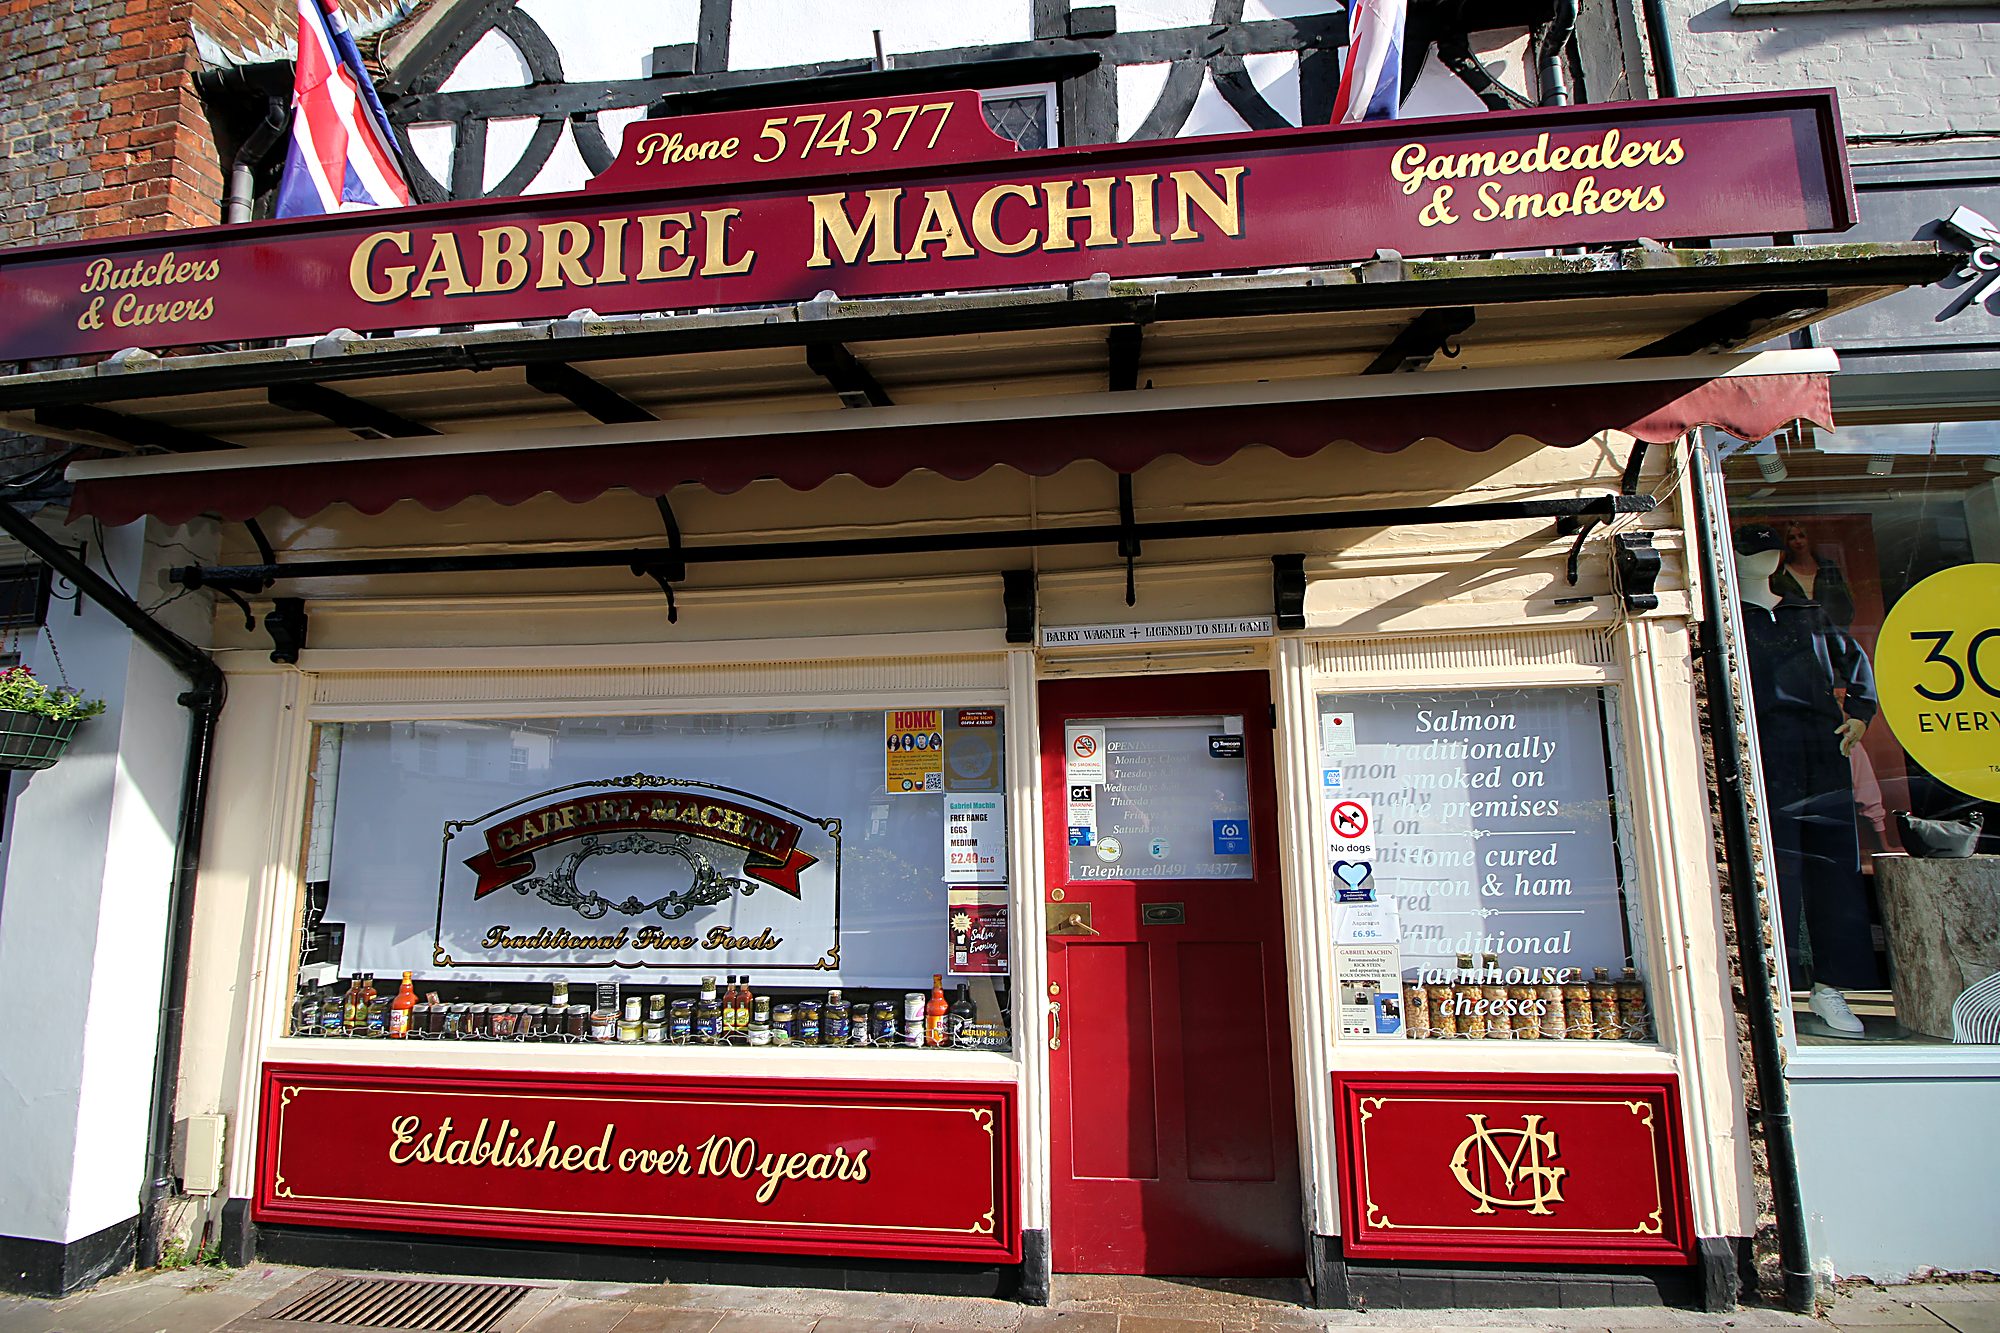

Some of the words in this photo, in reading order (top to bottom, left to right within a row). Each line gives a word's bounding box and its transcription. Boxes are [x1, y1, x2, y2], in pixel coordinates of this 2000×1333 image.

[636, 131, 739, 166] Phone
[753, 101, 954, 163] 574377
[1390, 128, 1686, 196] Gamedealers
[1418, 186, 1459, 227] &
[1473, 176, 1666, 222] Smokers
[350, 207, 756, 305] GABRIEL
[805, 165, 1247, 269] MACHIN
[80, 251, 220, 294] Butchers
[77, 296, 104, 331] &
[111, 295, 216, 328] Curers
[1046, 631, 1080, 642] BARRY
[1084, 628, 1126, 640] WAGNER
[1145, 625, 1193, 637] LICENSED
[1196, 624, 1209, 635] TO
[1212, 622, 1237, 633] SELL
[1239, 620, 1270, 632] GAME
[894, 711, 936, 729] HONK!
[1415, 709, 1516, 733] Salmon
[1383, 735, 1556, 764] traditionally
[1402, 766, 1501, 790] smoked
[1511, 770, 1545, 788] on
[1391, 797, 1431, 818] the
[1441, 795, 1559, 824] premises
[950, 826, 968, 834] EGGS
[950, 839, 978, 847] MEDIUM
[1330, 844, 1344, 852] No
[1347, 844, 1371, 854] dogs
[1485, 843, 1558, 867] cured
[1395, 875, 1471, 897] bacon
[1481, 873, 1504, 897] &
[1514, 873, 1572, 897] ham
[481, 925, 630, 952] Traditional
[631, 925, 698, 952] Fine
[700, 926, 783, 951] Foods
[970, 927, 994, 941] Salsa
[1352, 930, 1376, 938] £6.95
[1405, 930, 1572, 955] Traditional
[969, 941, 998, 955] Evening
[1412, 961, 1571, 990] farmhouse
[1440, 992, 1547, 1017] cheeses
[961, 1029, 986, 1037] MERLIN
[388, 1114, 614, 1172] Established
[618, 1142, 691, 1175] over
[696, 1134, 756, 1178] 100
[754, 1145, 871, 1204] years
